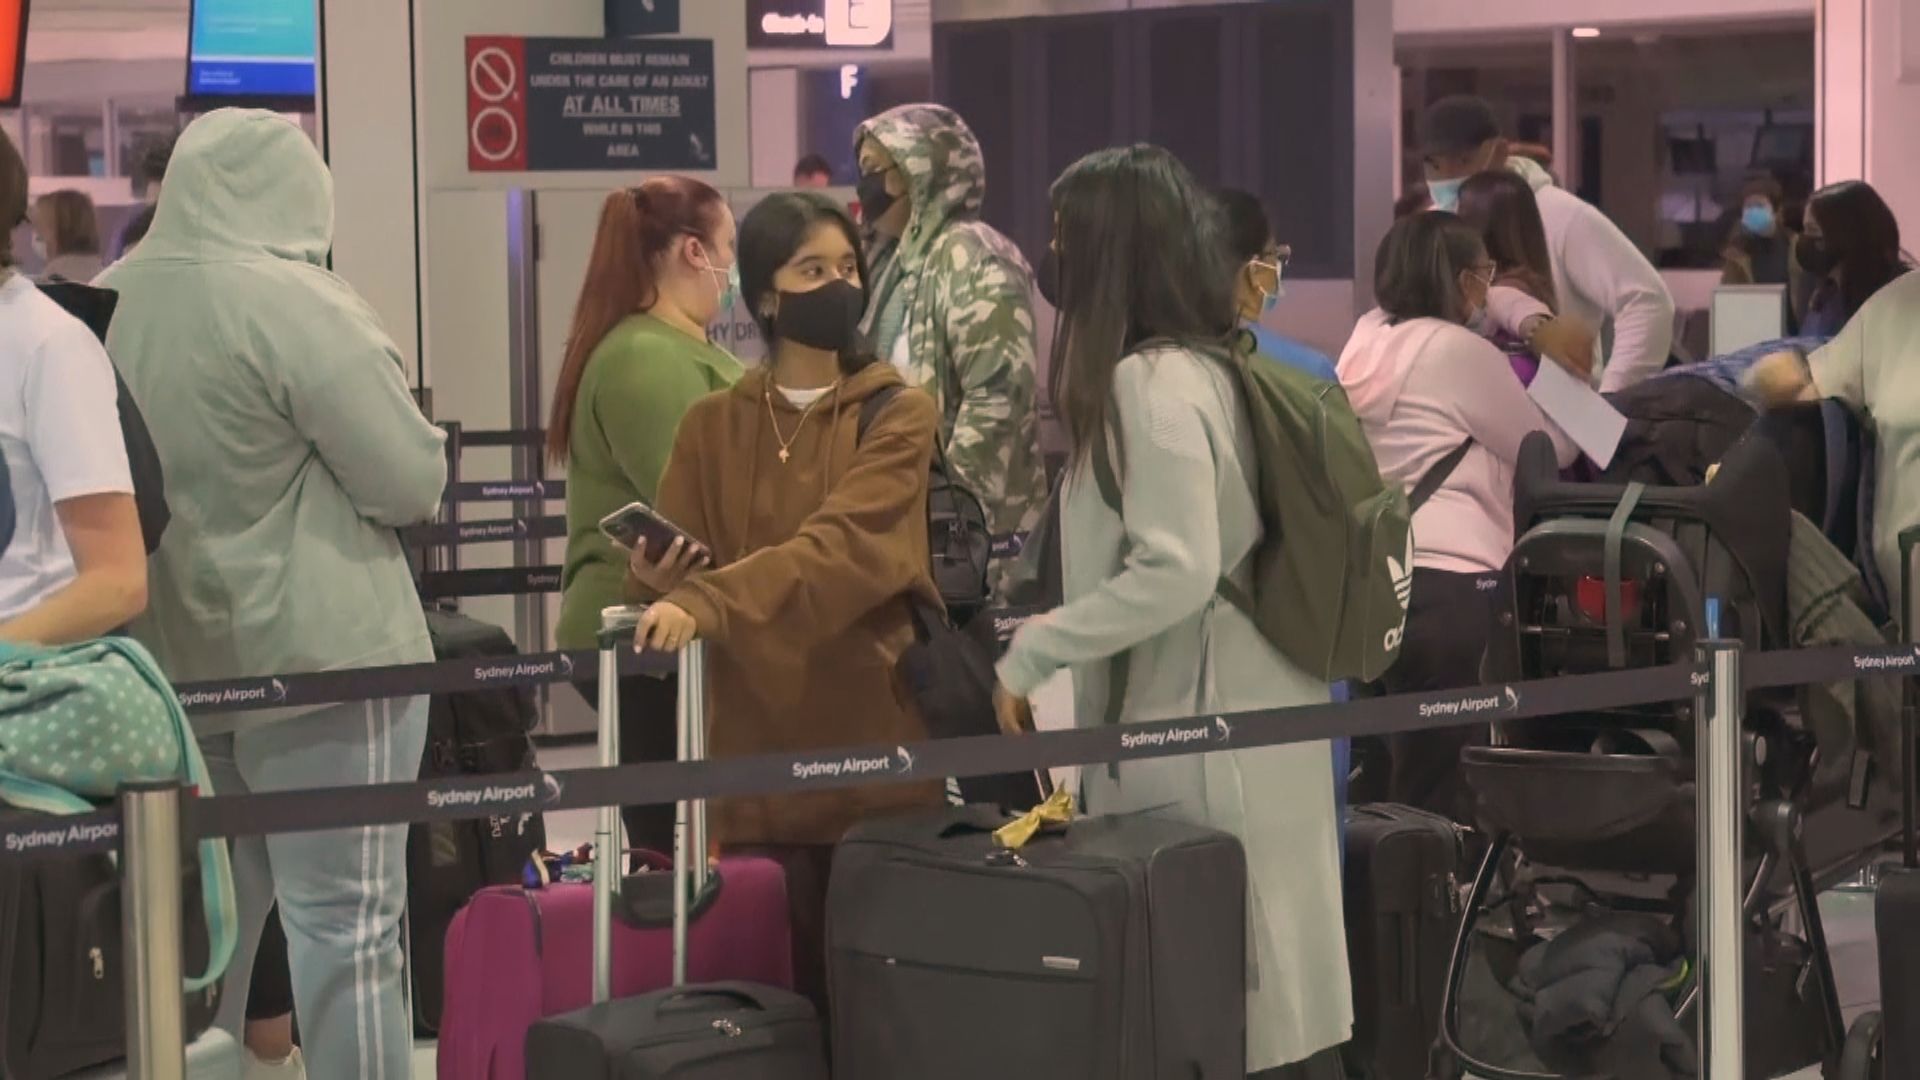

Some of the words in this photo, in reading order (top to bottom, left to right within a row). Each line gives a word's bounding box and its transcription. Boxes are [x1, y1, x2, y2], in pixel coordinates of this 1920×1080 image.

[550, 53, 607, 66] CHILDREN
[609, 54, 642, 66] MUST
[645, 54, 690, 66] REMAIN
[530, 75, 571, 88] UNDER
[574, 75, 595, 88] THE
[599, 75, 630, 88] CARE
[633, 75, 648, 88] OF
[652, 75, 669, 88] AN
[671, 75, 708, 88] ADULT
[841, 64, 858, 98] F
[563, 96, 585, 114] AT
[591, 96, 624, 114] ALL
[628, 96, 681, 114] TIMES
[583, 123, 618, 136] WHILE
[620, 123, 634, 136] IN
[636, 123, 662, 136] THIS
[606, 143, 640, 157] AREA
[482, 486, 508, 496] Sydney
[509, 484, 534, 496] Airport
[460, 526, 486, 537] Sydney
[488, 524, 513, 536] Airport
[527, 574, 559, 585] Sydney
[1475, 578, 1498, 590] Sydn
[1853, 655, 1885, 669] Sydney
[1886, 654, 1915, 668] Airport
[474, 666, 514, 681] Sydney
[516, 661, 554, 676] Airport
[1690, 671, 1709, 686] Syd
[179, 691, 221, 706] Sydney
[223, 687, 265, 701] Airport
[1419, 702, 1459, 717] Sydney
[1460, 696, 1499, 712] Airport
[1121, 731, 1165, 748] Sydney
[1166, 726, 1208, 742] Airport
[793, 761, 841, 779] Sydney
[842, 756, 889, 773] Airport
[427, 789, 481, 807] Sydney
[483, 783, 535, 801] Airport
[5, 830, 66, 851] Sydney
[67, 823, 118, 842] Airpor
